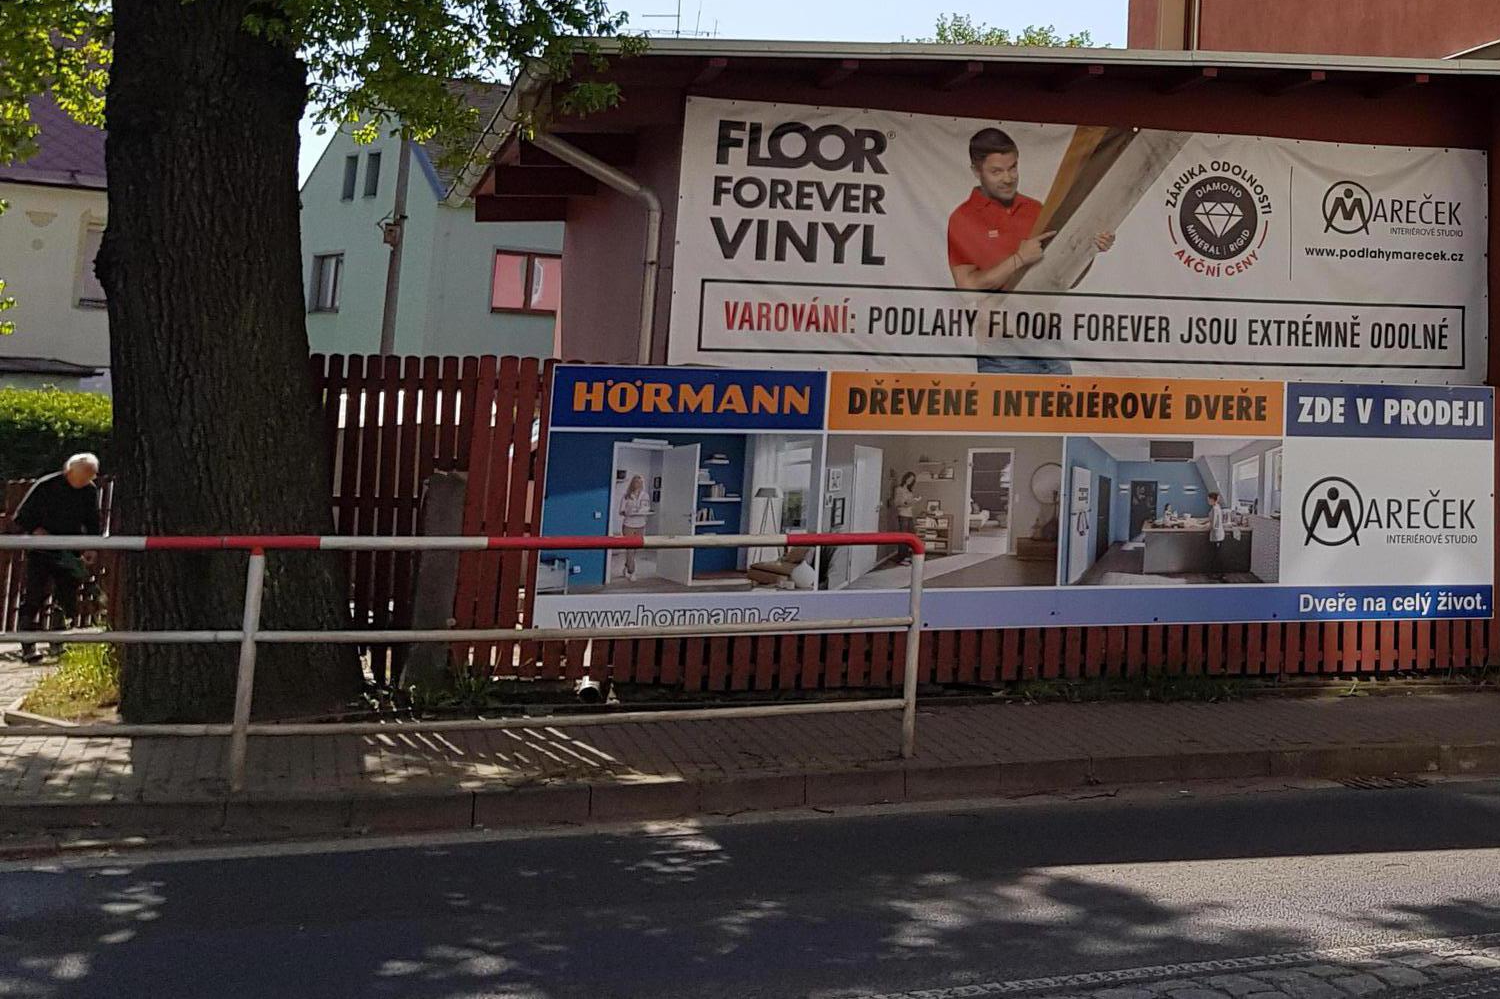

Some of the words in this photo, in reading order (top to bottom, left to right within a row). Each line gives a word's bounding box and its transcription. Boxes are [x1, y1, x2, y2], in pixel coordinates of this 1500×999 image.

[715, 119, 889, 174] FLOOR
[712, 175, 887, 215] FOREVER
[1165, 163, 1207, 208] ZÁRUKA
[1210, 160, 1272, 215] ODOLNOSTI
[1195, 182, 1242, 199] DIAMOND
[1322, 181, 1462, 235] MAREČEK
[710, 217, 887, 266] VINYL
[1186, 224, 1221, 255] MINERAL
[1228, 229, 1250, 252] RIGID
[1437, 229, 1464, 238] STUDIO
[1174, 248, 1221, 277] AKČNÍ
[1225, 250, 1258, 276] CENY
[1305, 245, 1464, 262] www.podlahymarecek.cz
[724, 297, 856, 335] VAROVÁNÍ:
[868, 306, 978, 339] PODLAHY
[988, 310, 1062, 341] FLOOR
[1074, 313, 1170, 344] FOREVER
[1180, 316, 1237, 346] JSOU
[1248, 314, 1361, 349] EXTRÉMNĚ
[1370, 317, 1449, 350] ODOLNÉ
[573, 379, 811, 415] HÖRMANN
[847, 379, 978, 416] DŘEVĚNÉ
[1185, 387, 1267, 421] DVEŘE
[1297, 396, 1346, 424] ZDE
[1356, 398, 1374, 425] V
[1384, 398, 1485, 427] PRODEJI
[1301, 476, 1476, 547] MAREČEK
[1386, 532, 1443, 545] INTERIÉROVÉ
[1444, 534, 1478, 545] STUDIO
[558, 605, 800, 630] www.hormann.cz
[1299, 592, 1357, 613] Dveře
[1362, 596, 1387, 612] na
[1391, 590, 1433, 616] celý
[1436, 589, 1488, 612] život.
